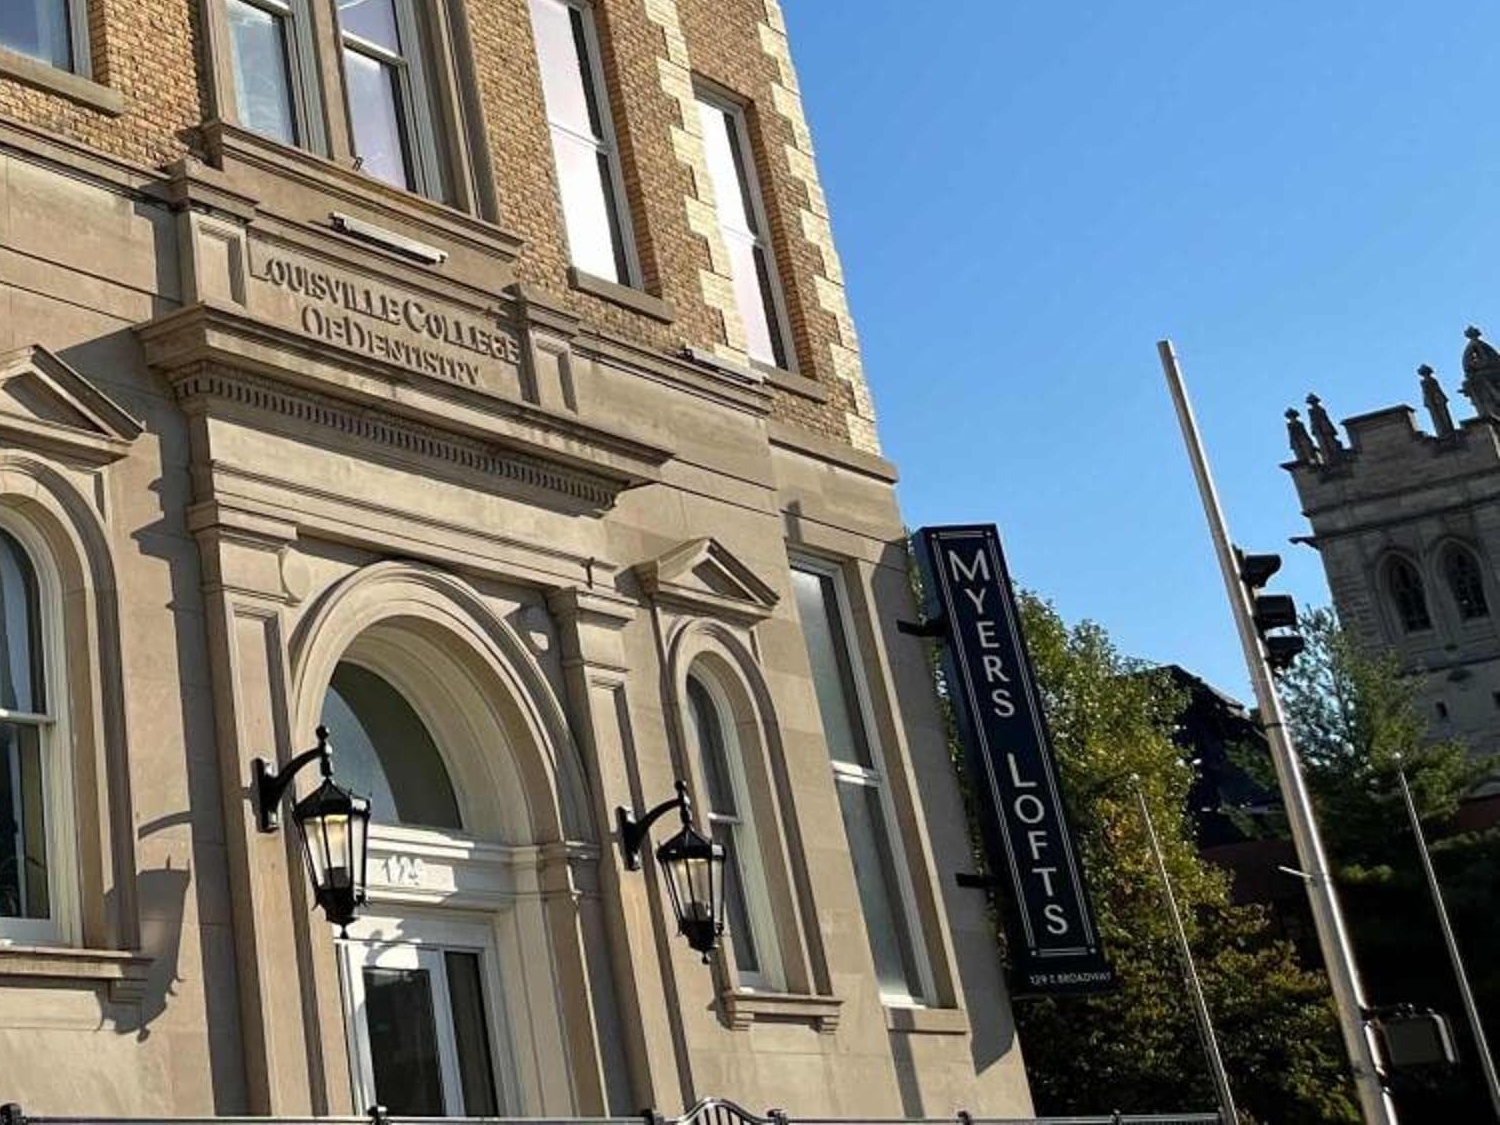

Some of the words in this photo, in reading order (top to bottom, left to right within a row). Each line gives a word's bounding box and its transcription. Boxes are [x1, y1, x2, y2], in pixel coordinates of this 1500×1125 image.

[251, 239, 401, 325] LOUISVILLE
[403, 298, 521, 365] COLLEGE
[346, 316, 481, 387] DENTISTRY
[948, 549, 1016, 718] MYERS
[1007, 752, 1069, 936] LOFTS
